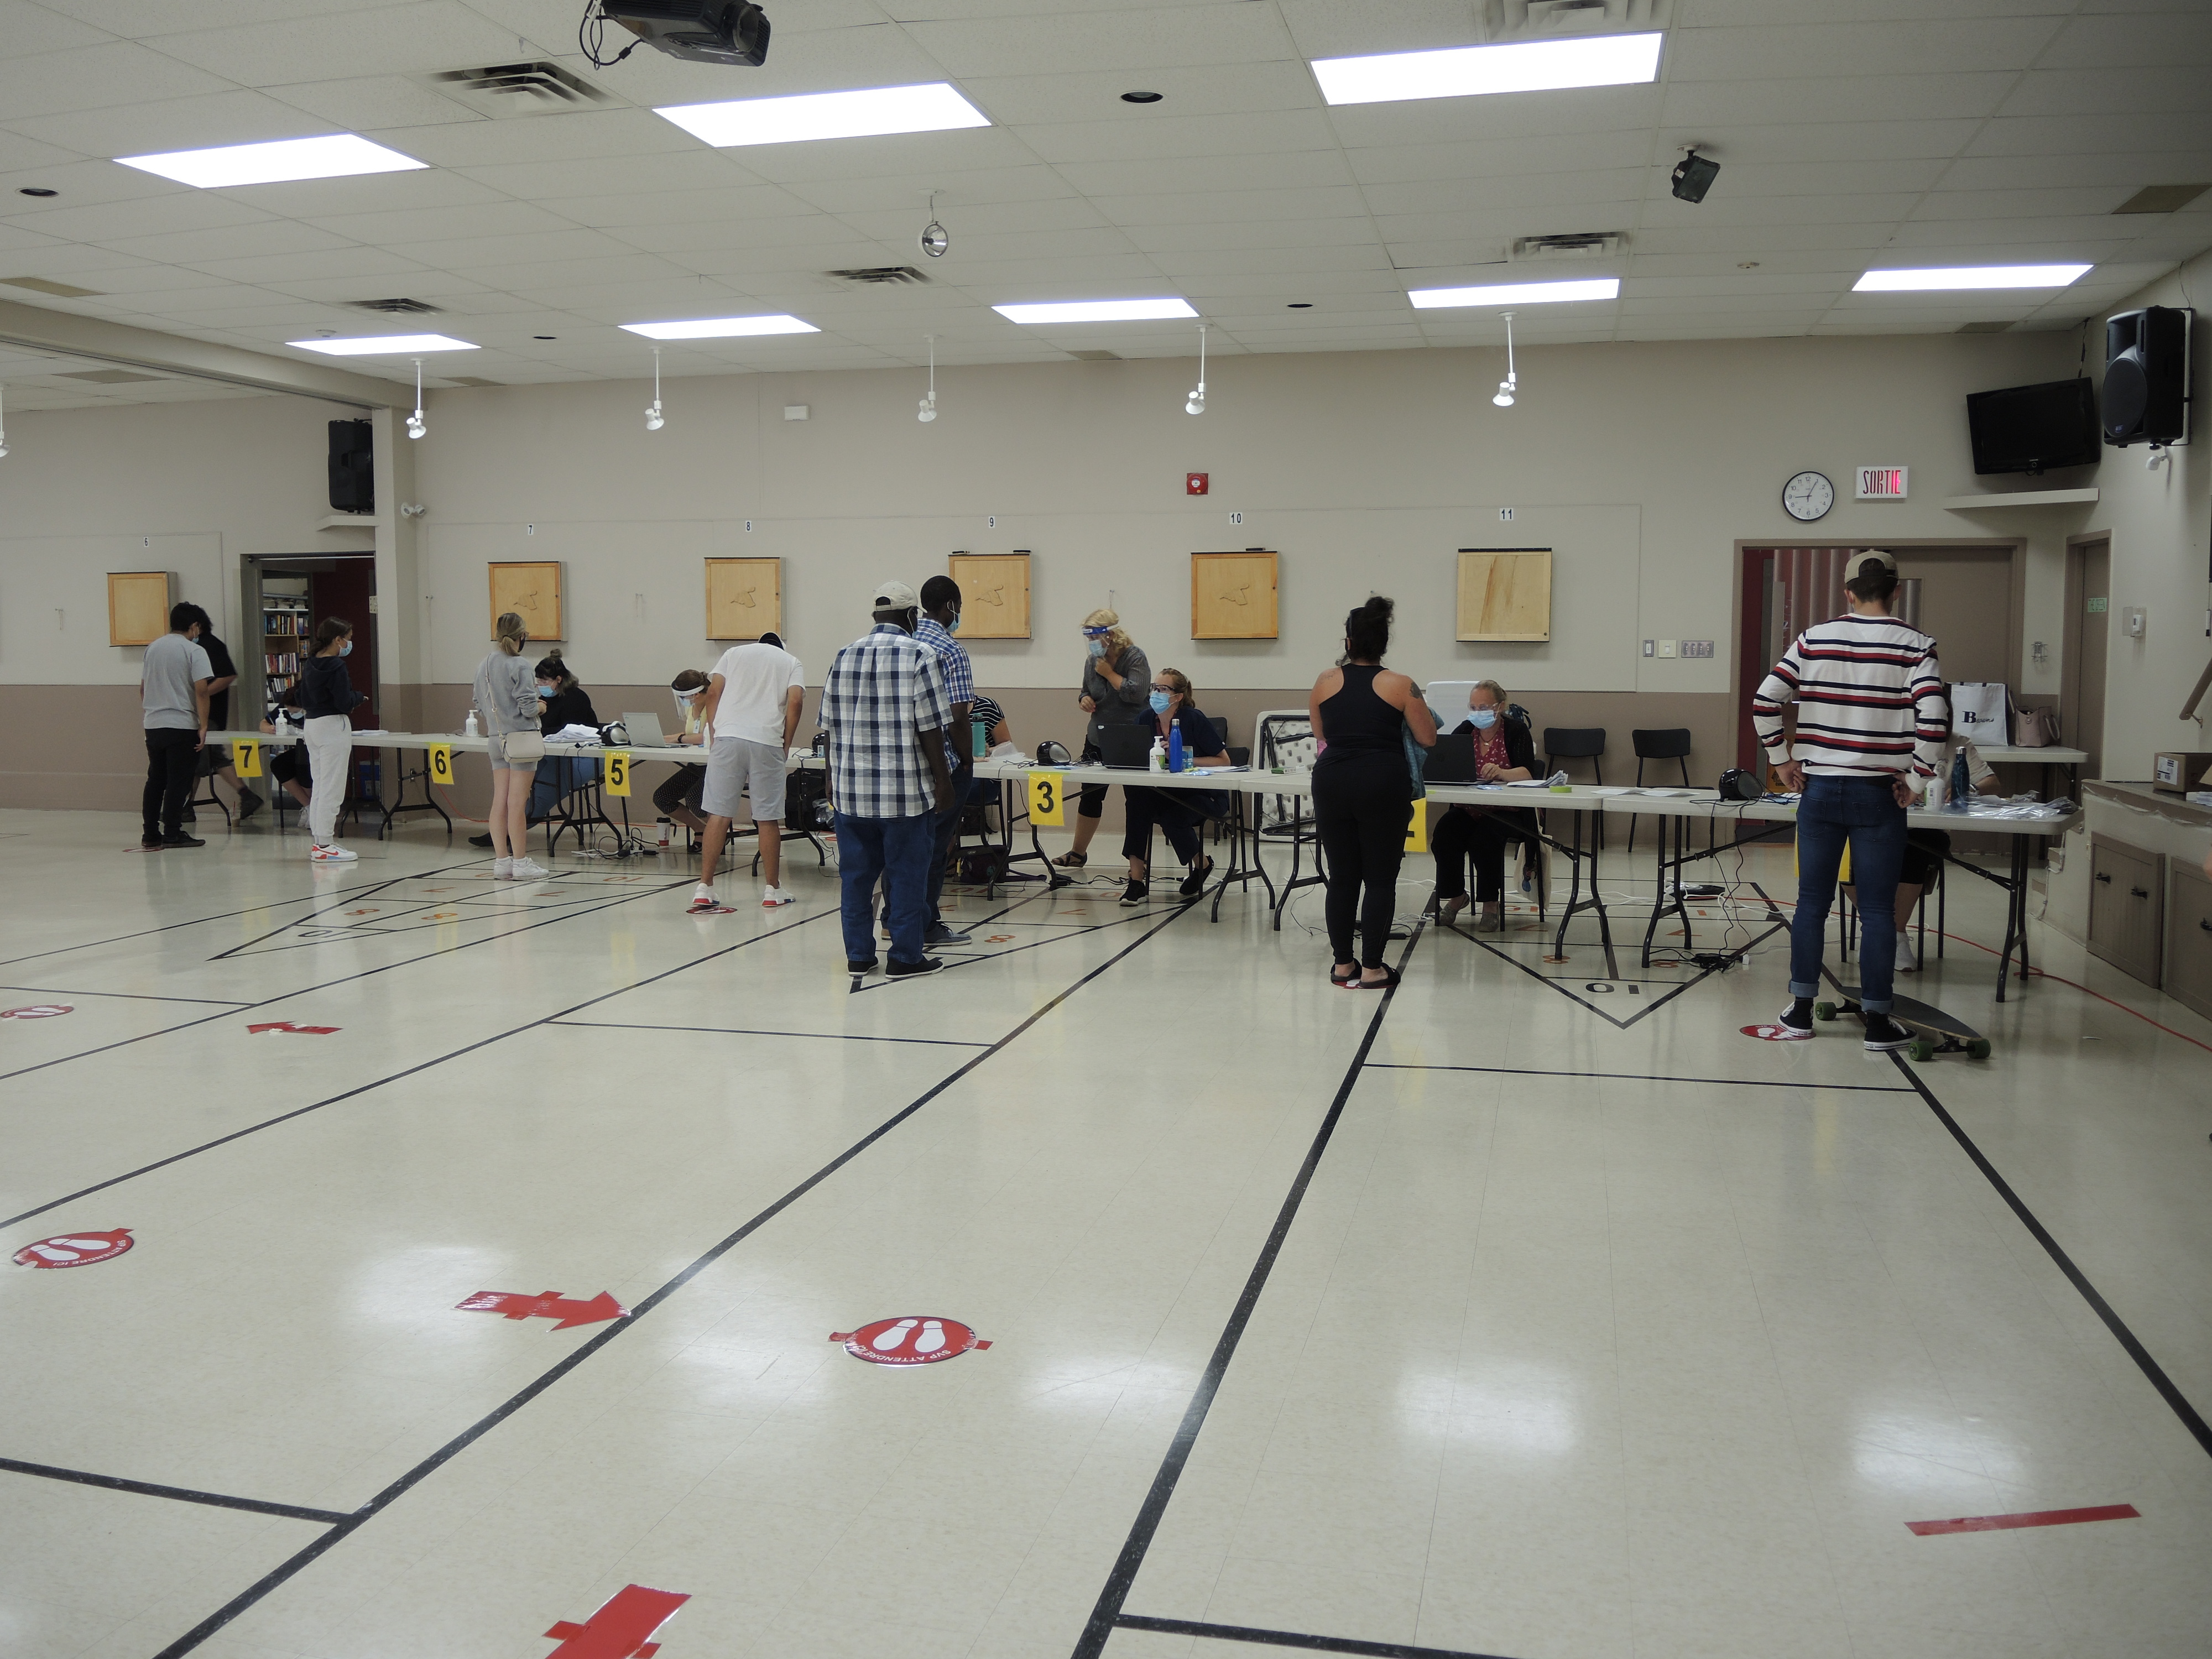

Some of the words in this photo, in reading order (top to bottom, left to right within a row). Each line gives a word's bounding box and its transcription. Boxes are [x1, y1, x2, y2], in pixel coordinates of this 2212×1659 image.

[1863, 469, 1902, 494] SORTIE
[1232, 513, 1241, 524] 10
[1501, 509, 1512, 519] 11
[747, 521, 750, 531] 8
[989, 518, 994, 527] 9
[529, 525, 533, 534] 7
[144, 538, 148, 546] 6
[239, 745, 253, 768] 7
[435, 750, 446, 775] 6
[611, 759, 623, 785] 5
[1037, 781, 1054, 813] 3
[71, 1247, 123, 1265] ATTENDRE
[863, 1350, 925, 1362] ATTENDRE
[929, 1349, 952, 1359] SVP
